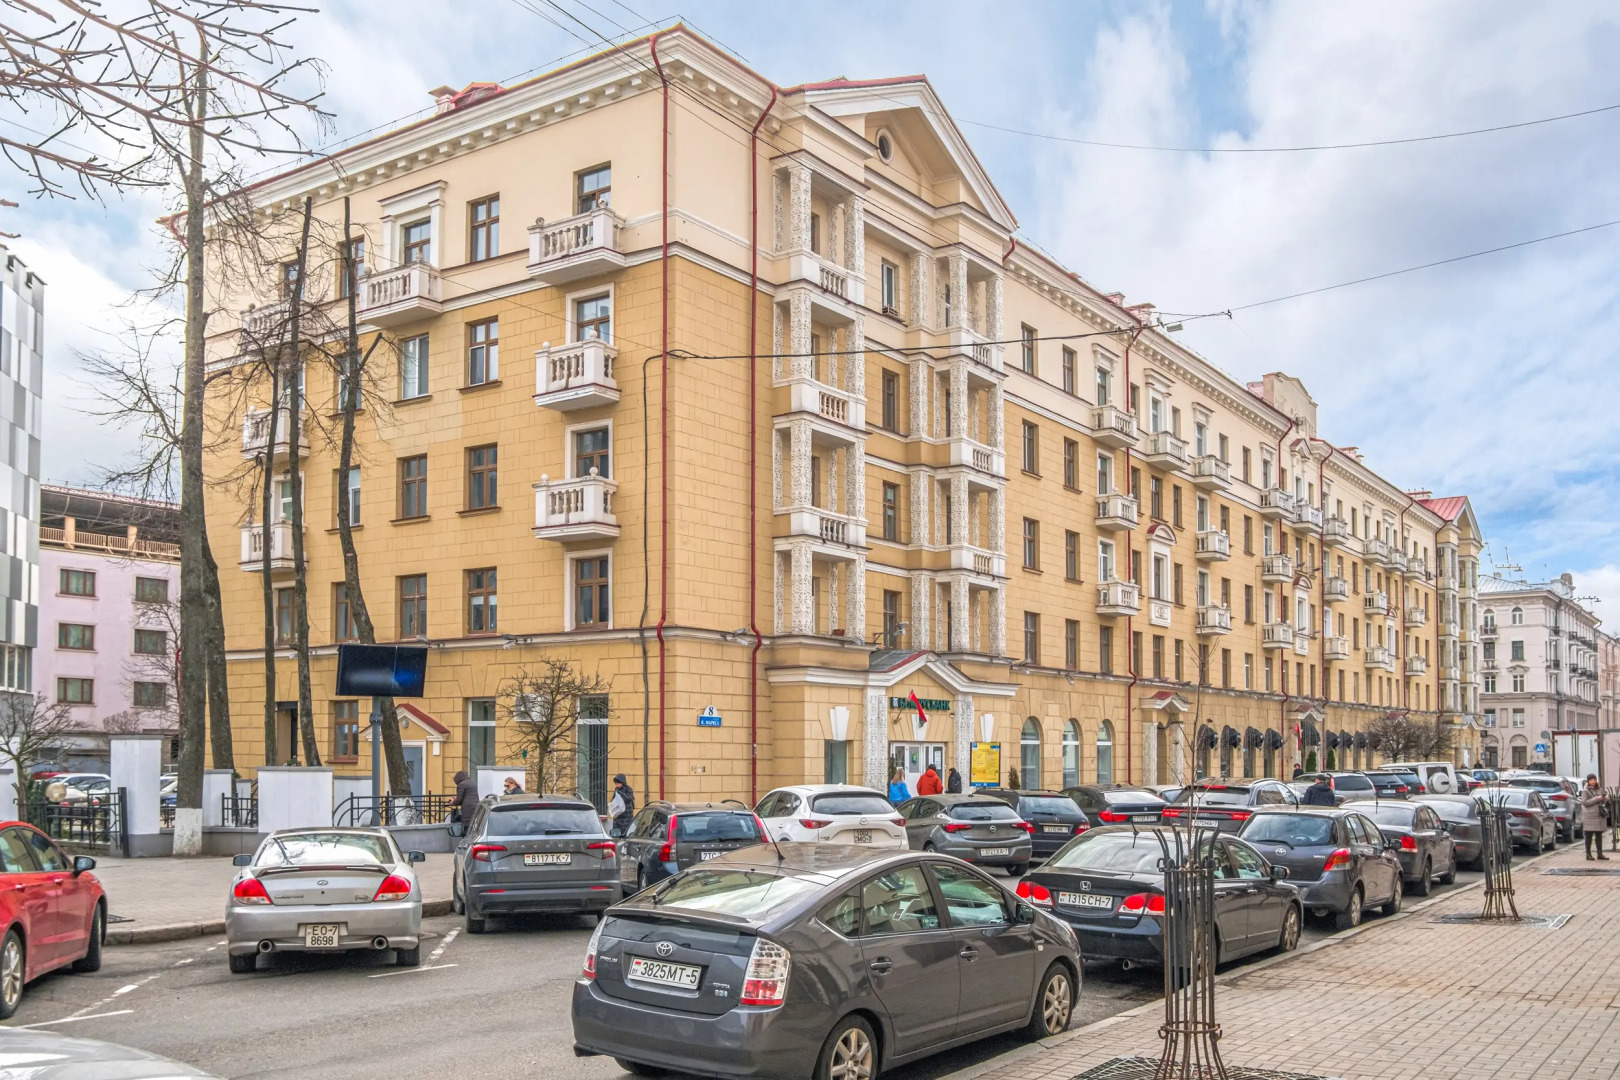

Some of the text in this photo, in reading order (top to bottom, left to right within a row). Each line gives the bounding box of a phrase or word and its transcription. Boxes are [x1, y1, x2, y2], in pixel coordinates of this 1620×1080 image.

[708, 706, 714, 716] 8
[531, 852, 570, 863] 8117TK-7
[1067, 893, 1111, 907] 1315CH-7
[311, 936, 334, 946] 8698
[640, 962, 699, 984] 3825MT-5
